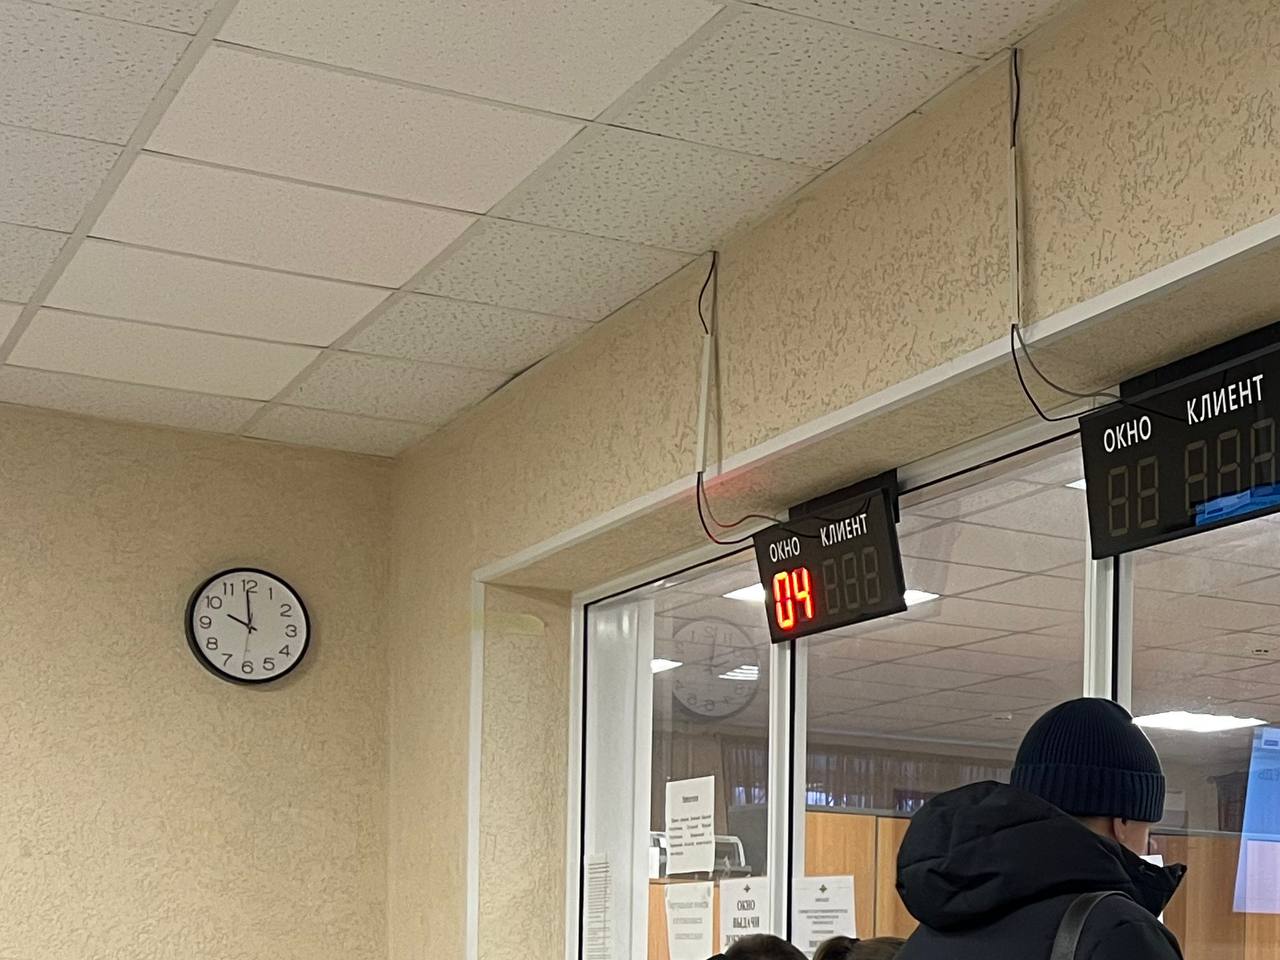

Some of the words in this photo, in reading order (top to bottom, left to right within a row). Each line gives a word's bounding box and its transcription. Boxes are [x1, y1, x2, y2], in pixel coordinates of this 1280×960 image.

[1186, 374, 1263, 425] КЛИЕНТ
[1103, 416, 1152, 453] ОКНО
[820, 513, 867, 547] КЛИЕНТ
[769, 536, 800, 562] ОКНО
[223, 582, 234, 596] 11
[242, 579, 258, 594] 12
[268, 587, 273, 600] 1
[205, 595, 222, 610] 10
[773, 567, 815, 629] 04
[280, 603, 292, 617] 2
[199, 616, 212, 629] 9
[285, 624, 297, 638] 3
[206, 637, 218, 650] 8
[278, 644, 291, 658] 4
[221, 653, 233, 666] 7
[262, 657, 275, 671] 5
[241, 660, 253, 674] 6
